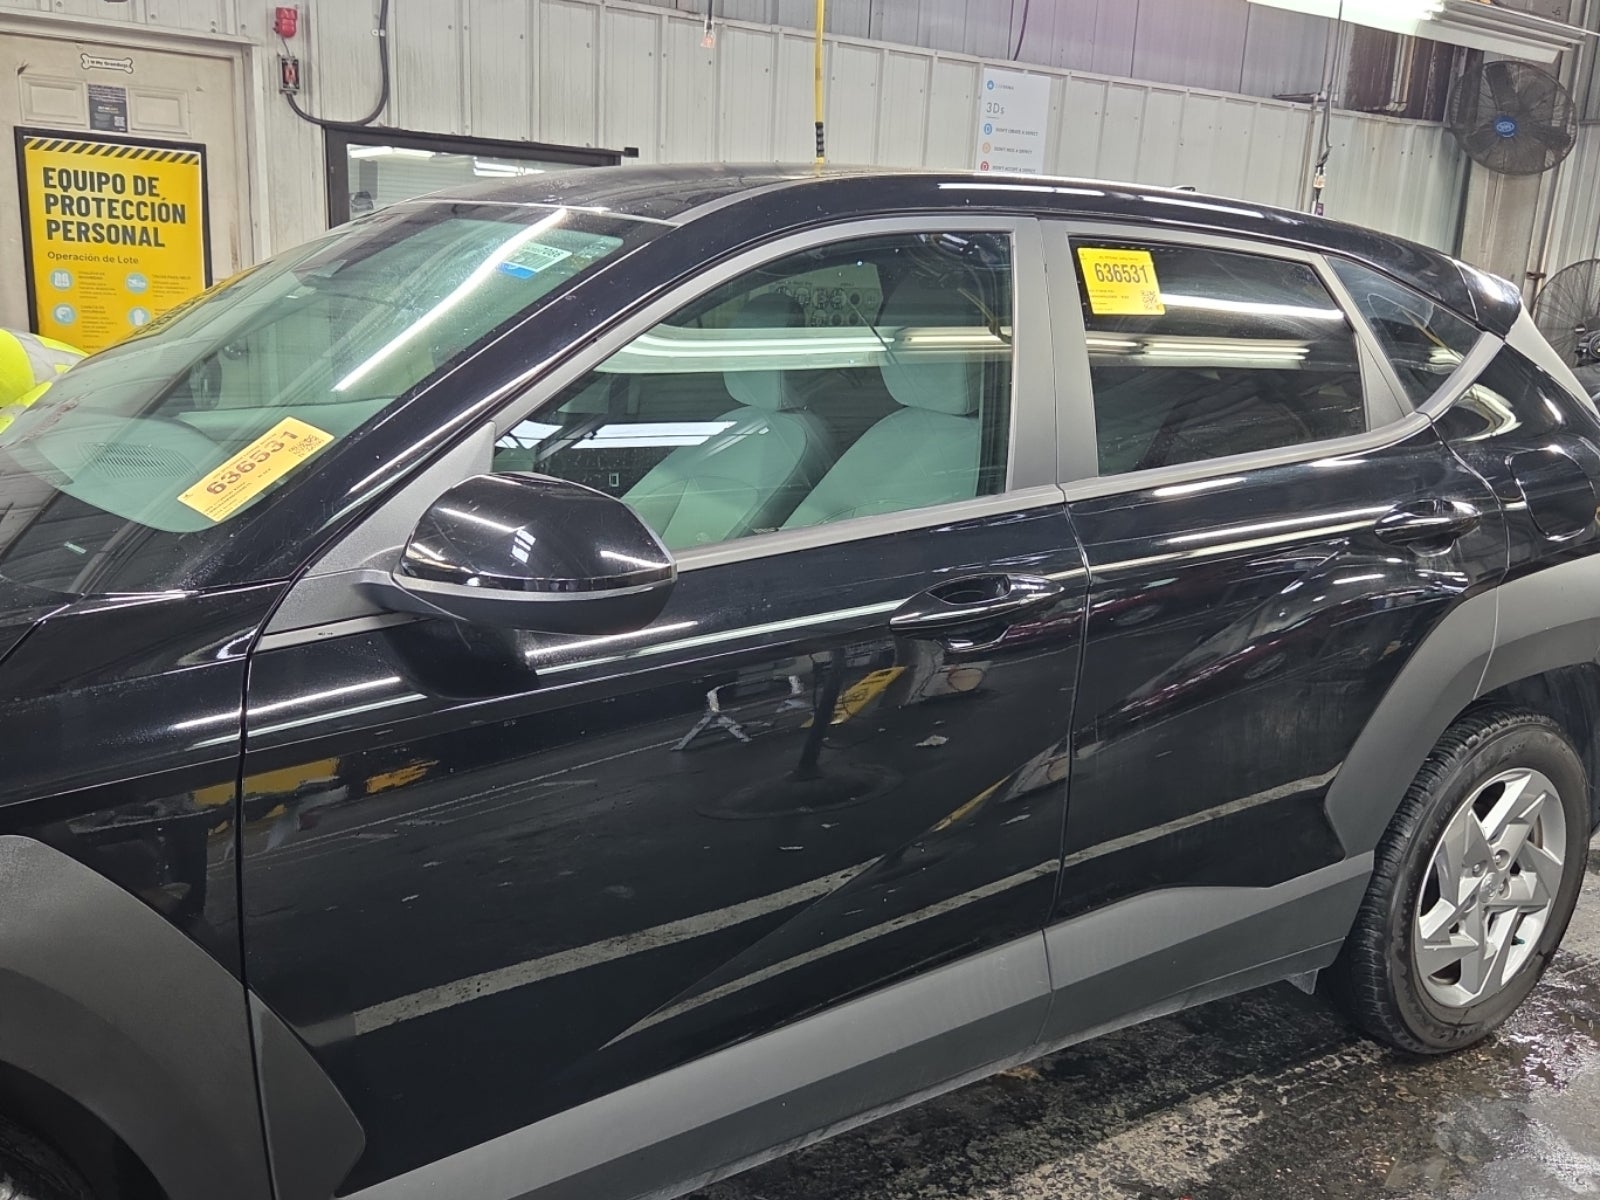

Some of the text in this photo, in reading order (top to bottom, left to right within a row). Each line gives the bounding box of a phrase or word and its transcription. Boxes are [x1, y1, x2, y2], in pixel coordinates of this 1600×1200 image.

[986, 102, 1005, 115] 3Ds
[43, 166, 160, 197] EQUIPO DE
[44, 193, 186, 224] PROTECCIÓN
[46, 219, 165, 248] PERSONAL
[47, 250, 139, 265] Operación de Lote
[1094, 263, 1149, 283] 636531
[206, 431, 298, 495] 636531
